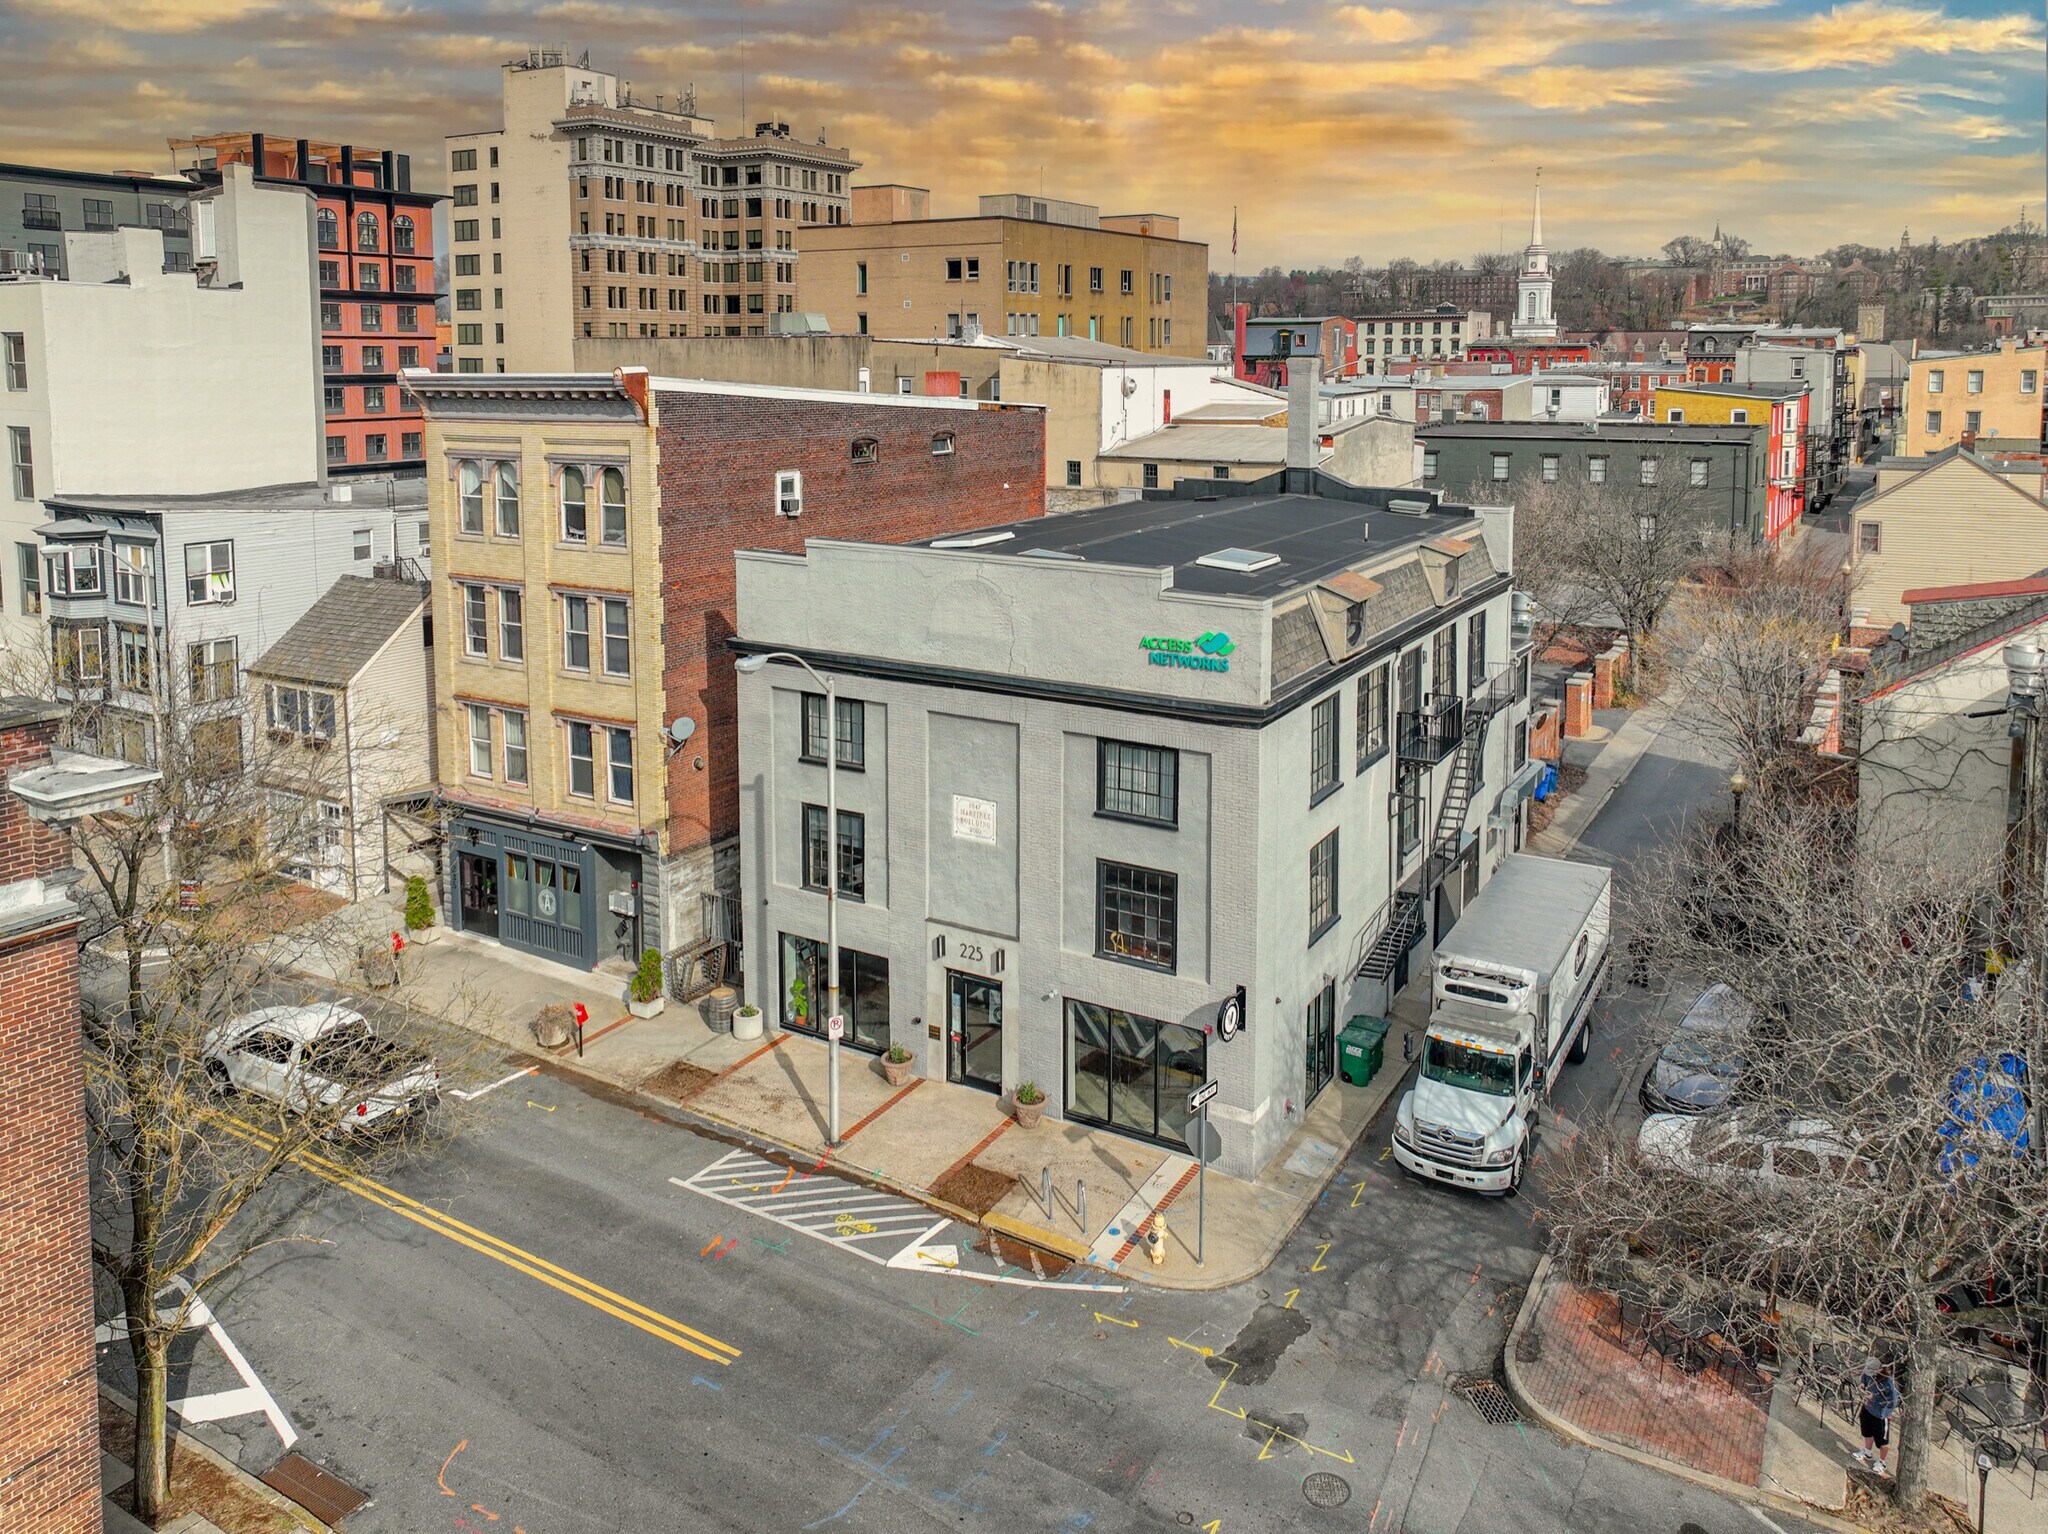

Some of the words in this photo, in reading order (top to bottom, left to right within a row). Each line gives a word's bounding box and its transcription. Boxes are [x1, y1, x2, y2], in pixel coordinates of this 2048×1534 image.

[1139, 635, 1193, 653] ACCESS
[1148, 651, 1230, 673] NETWORKS
[960, 817, 991, 829] BUILDING
[959, 943, 983, 961] 225
